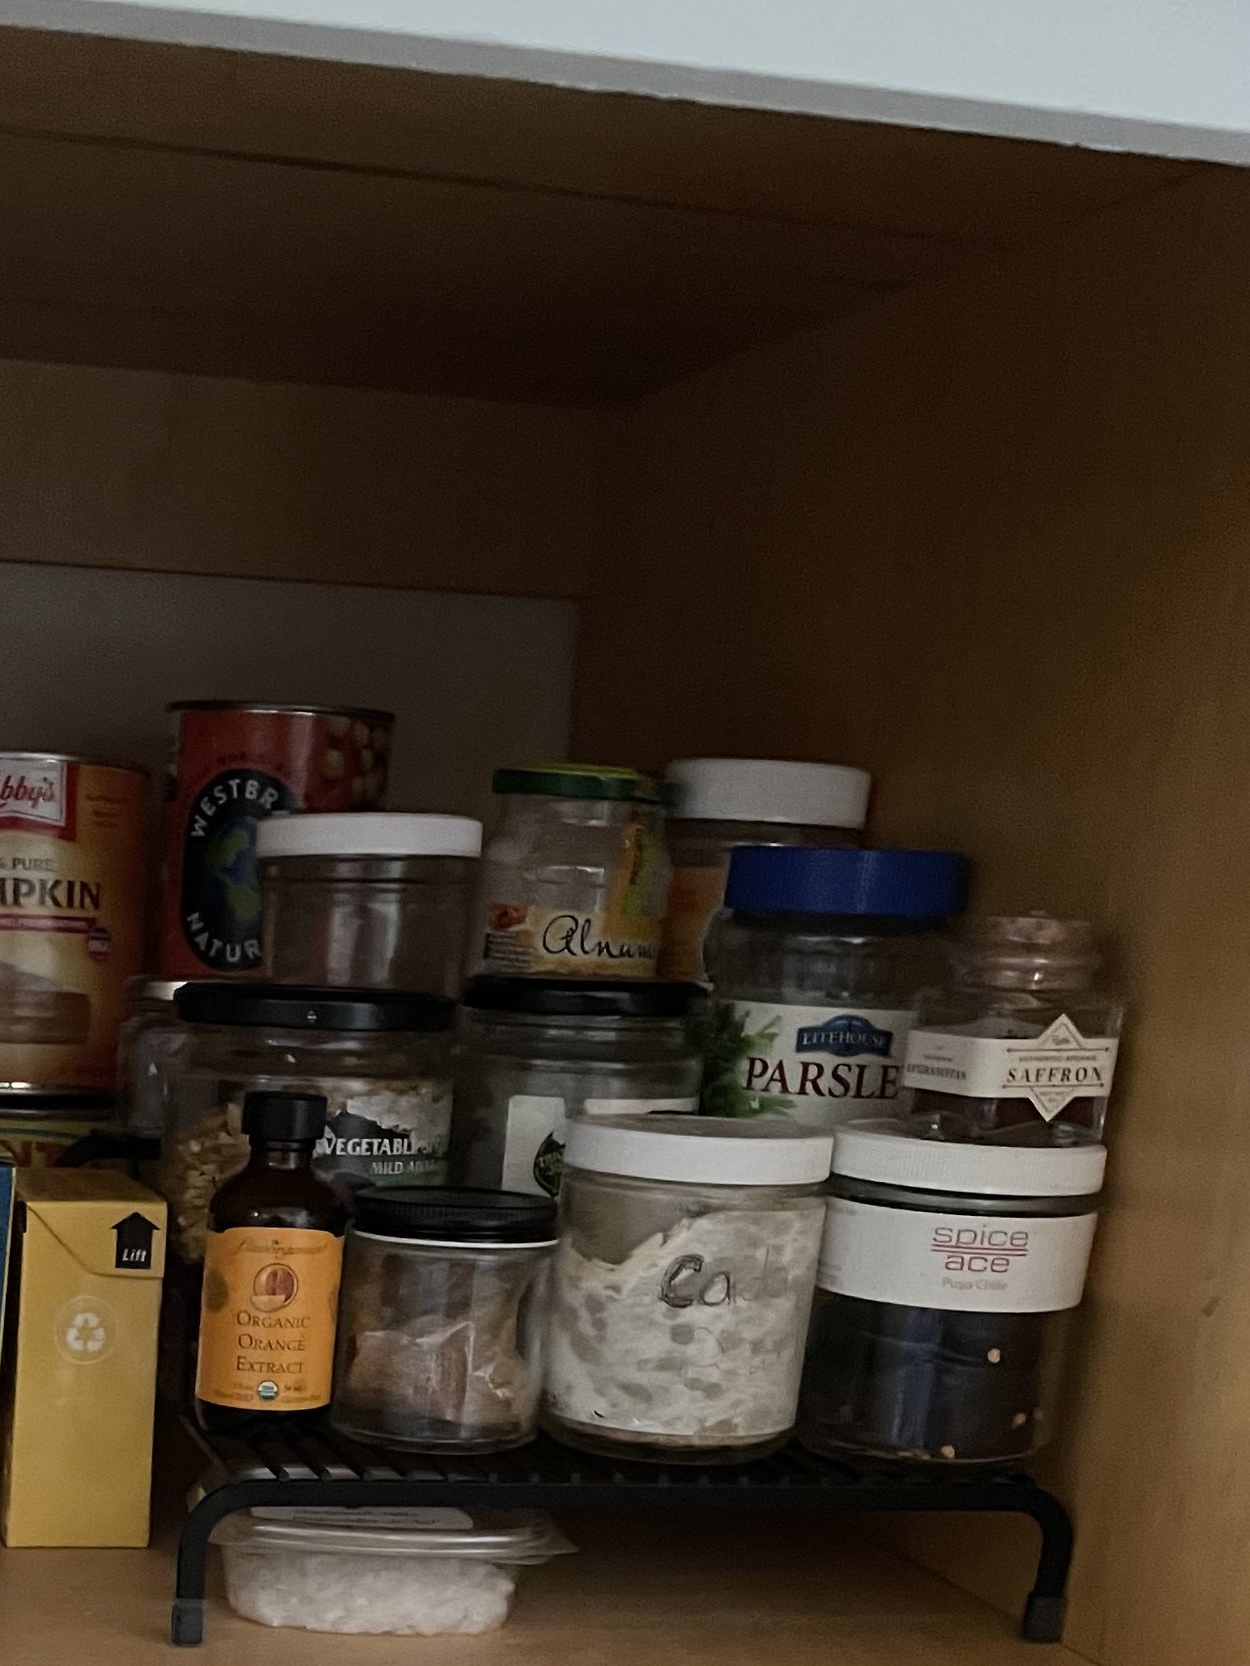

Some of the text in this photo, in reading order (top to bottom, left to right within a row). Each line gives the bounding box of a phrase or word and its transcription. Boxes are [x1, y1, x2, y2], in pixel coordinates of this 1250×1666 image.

[191, 778, 280, 837] WESTBR
[12, 857, 55, 872] PURE
[186, 912, 262, 963] NATUR
[803, 1031, 888, 1048] LITEHOUSE
[742, 1057, 900, 1099] PARSLE
[1006, 1066, 1102, 1083] SAFFRON
[324, 1126, 418, 1155] VEGETABL
[933, 1224, 1029, 1248] spice
[122, 1248, 147, 1263] Lift
[945, 1255, 1010, 1274] ace
[237, 1310, 310, 1328] ORGANIC
[238, 1334, 306, 1351] ORANGE
[237, 1356, 304, 1373] EXTRACT
